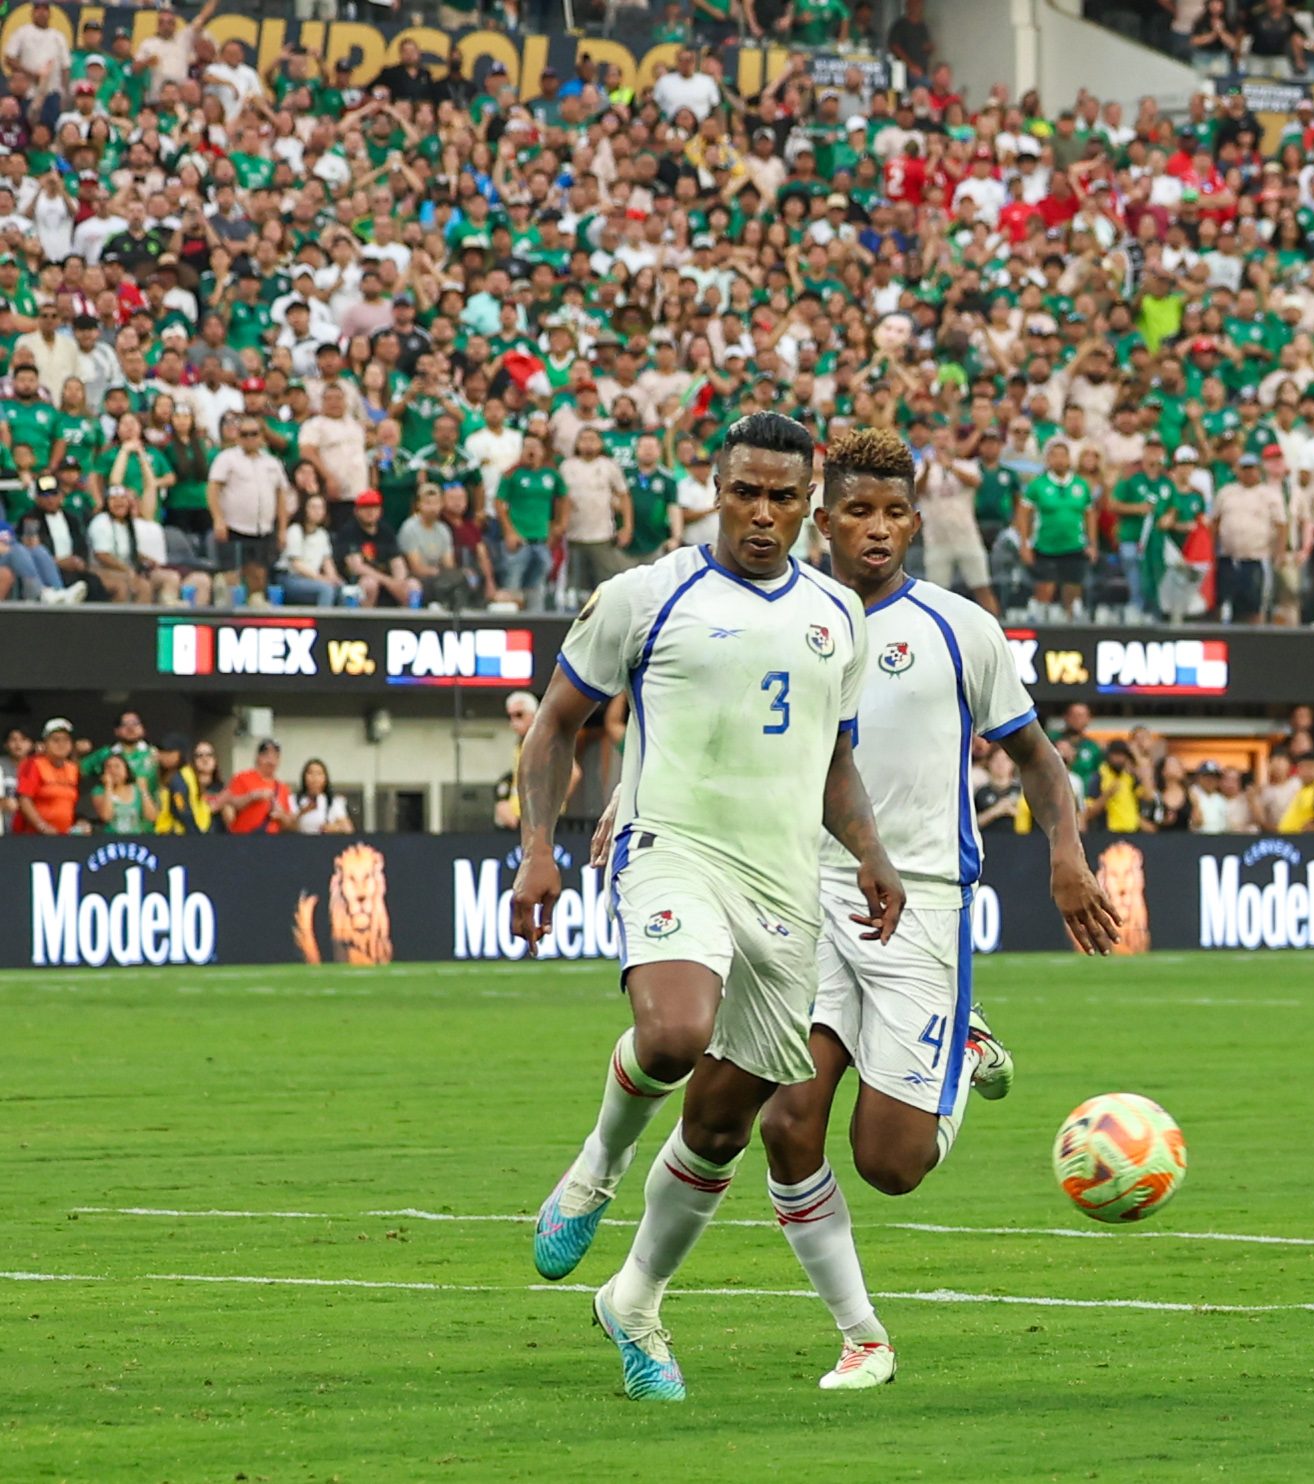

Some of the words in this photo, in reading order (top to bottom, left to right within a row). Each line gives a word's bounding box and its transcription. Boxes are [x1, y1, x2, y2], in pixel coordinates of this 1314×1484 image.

[217, 627, 318, 675] MEX
[386, 629, 476, 677] PAN
[1096, 641, 1176, 685] PAN
[760, 671, 790, 735] 3
[31, 861, 216, 966] Modelo
[918, 1014, 947, 1069] 4
